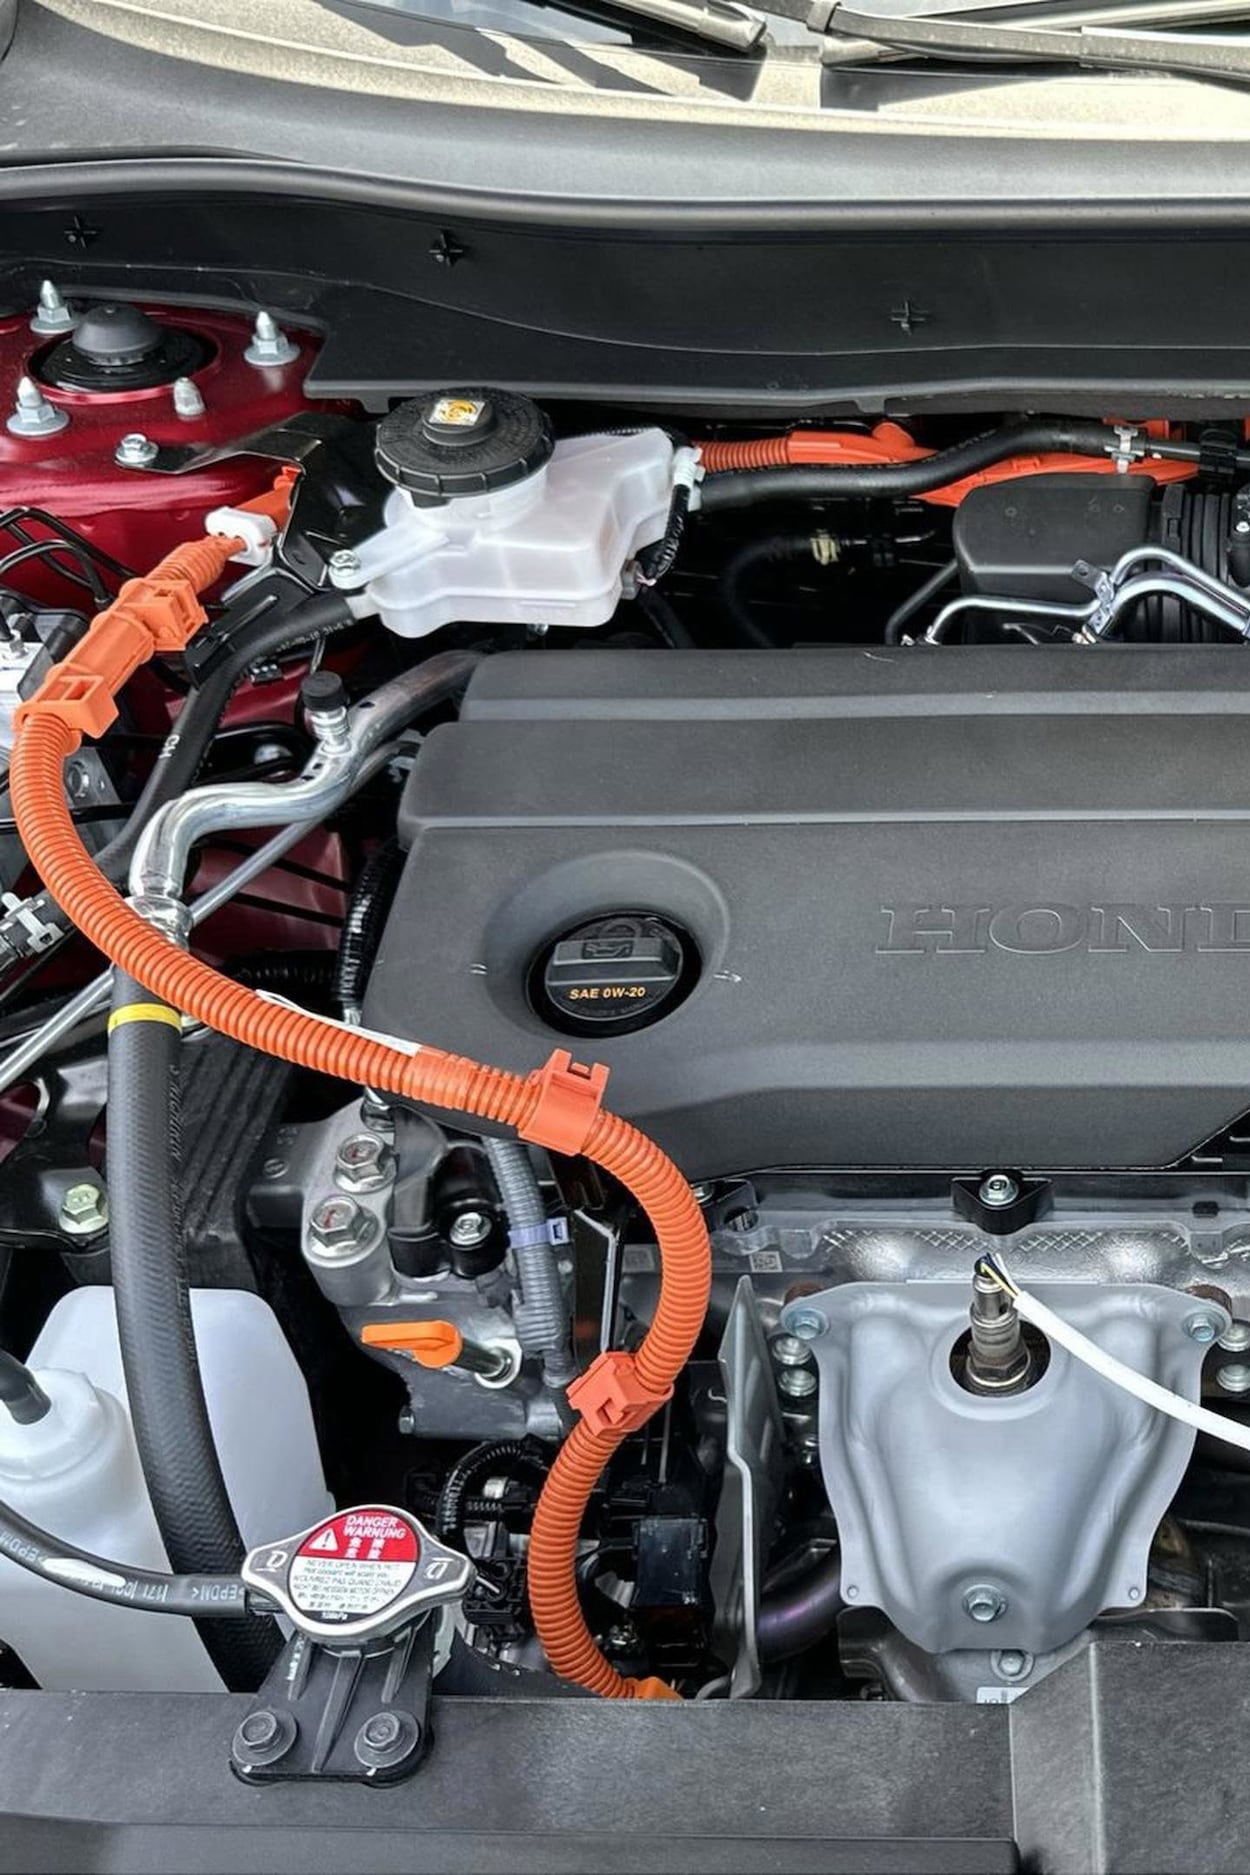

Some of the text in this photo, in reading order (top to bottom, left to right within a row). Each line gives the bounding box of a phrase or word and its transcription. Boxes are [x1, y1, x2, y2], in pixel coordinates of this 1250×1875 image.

[569, 986, 646, 1000] SAE 0W-20
[345, 1515, 400, 1529] DANGER
[343, 1525, 406, 1539] WARNUNG
